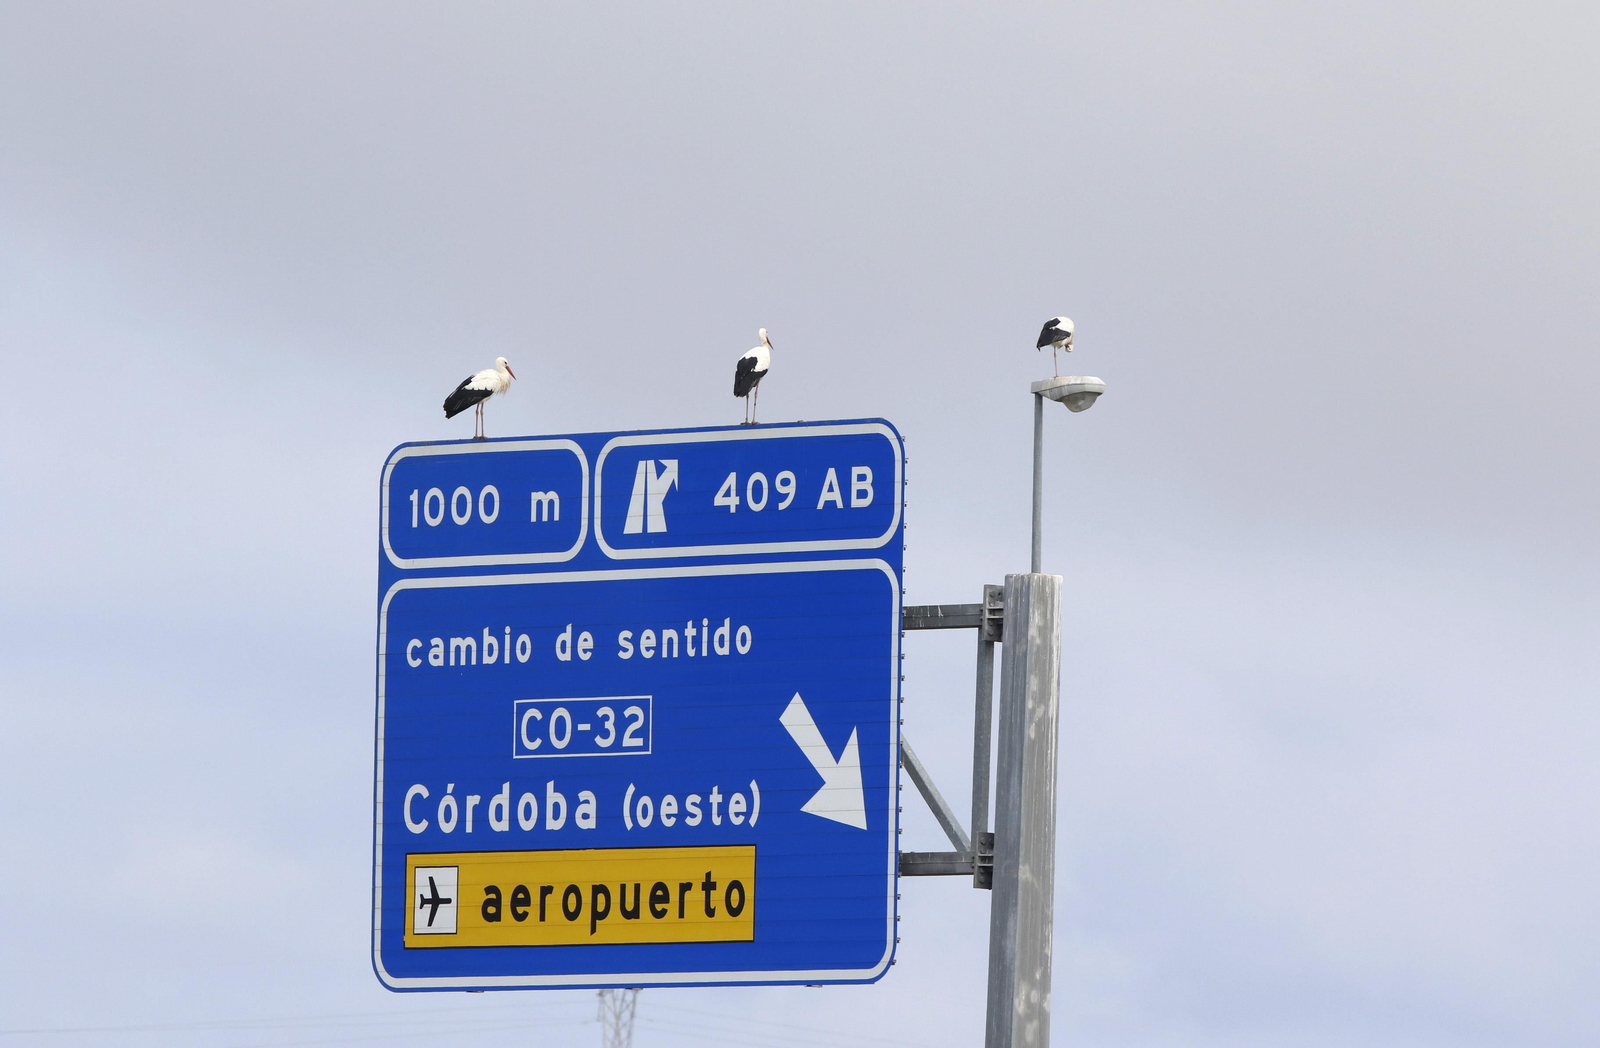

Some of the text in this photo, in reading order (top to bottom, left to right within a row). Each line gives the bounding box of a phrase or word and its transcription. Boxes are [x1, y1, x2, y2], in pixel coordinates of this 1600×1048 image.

[410, 485, 559, 527] 1000 m
[714, 466, 873, 513] 409 AB
[407, 618, 751, 667] cambio de sentido
[521, 706, 644, 750] CO-32
[404, 780, 760, 833] Córdoba (oeste)
[482, 871, 745, 935] aeropuerto
